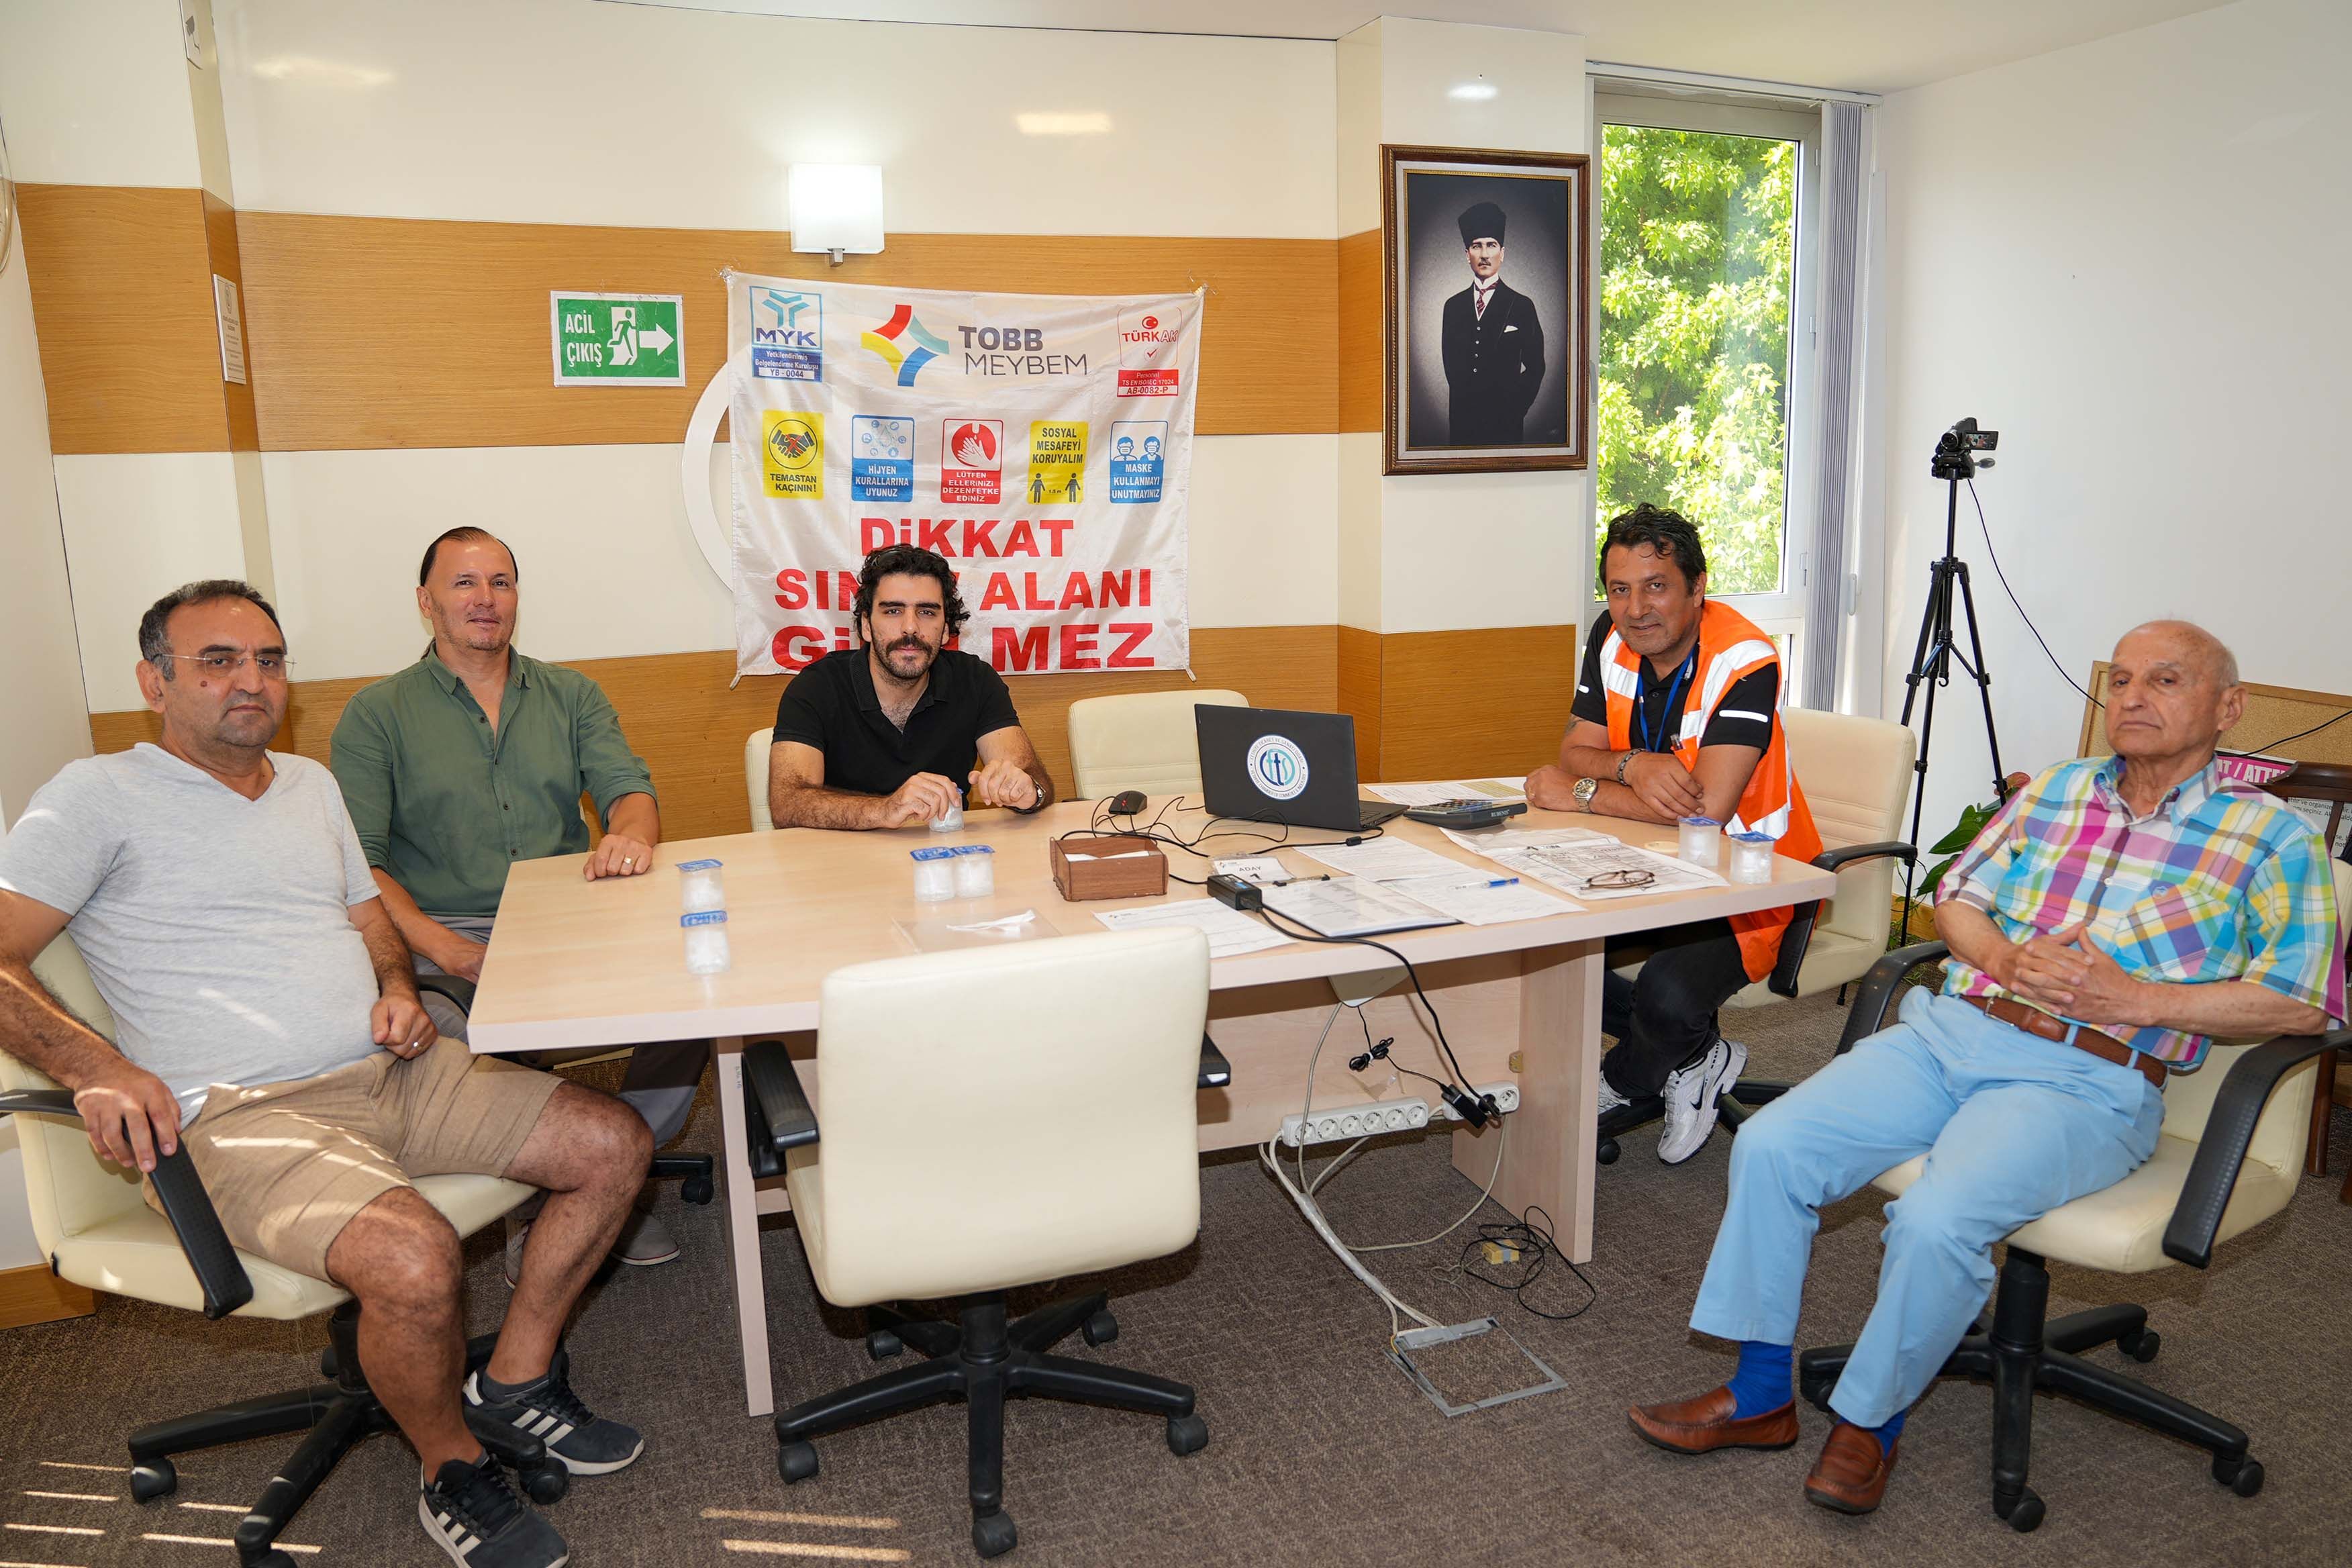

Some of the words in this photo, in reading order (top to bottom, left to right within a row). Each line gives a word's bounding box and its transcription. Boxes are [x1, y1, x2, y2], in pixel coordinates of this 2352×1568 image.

[565, 309, 595, 334] ACİL
[756, 327, 818, 347] MYK
[958, 326, 1043, 351] TOBB
[1122, 330, 1178, 343] TÜRKAK
[567, 342, 603, 368] ÇIKIŞ
[765, 350, 808, 361] Yetkilendirilmiş
[754, 359, 793, 369] Belgelendirme
[965, 352, 1087, 376] MEYBEM
[786, 370, 804, 378] 0044
[1126, 387, 1169, 395] AB-0082-P
[1042, 427, 1077, 438] SOSYAL
[1036, 438, 1081, 451] MESAFEYİ
[1032, 453, 1083, 464] KORUYALIM
[868, 464, 897, 475] HİJYEN
[1125, 463, 1153, 473] MASKE
[769, 473, 817, 483] TEMASTAN
[956, 471, 987, 479] LÜTFEN
[854, 476, 910, 487] KURALLARINA
[1113, 476, 1160, 486] KULLANMAYI
[865, 488, 898, 497] UYUNUZ
[1112, 489, 1161, 499] UNUTMAYINIZ
[979, 569, 1151, 611] ALANI
